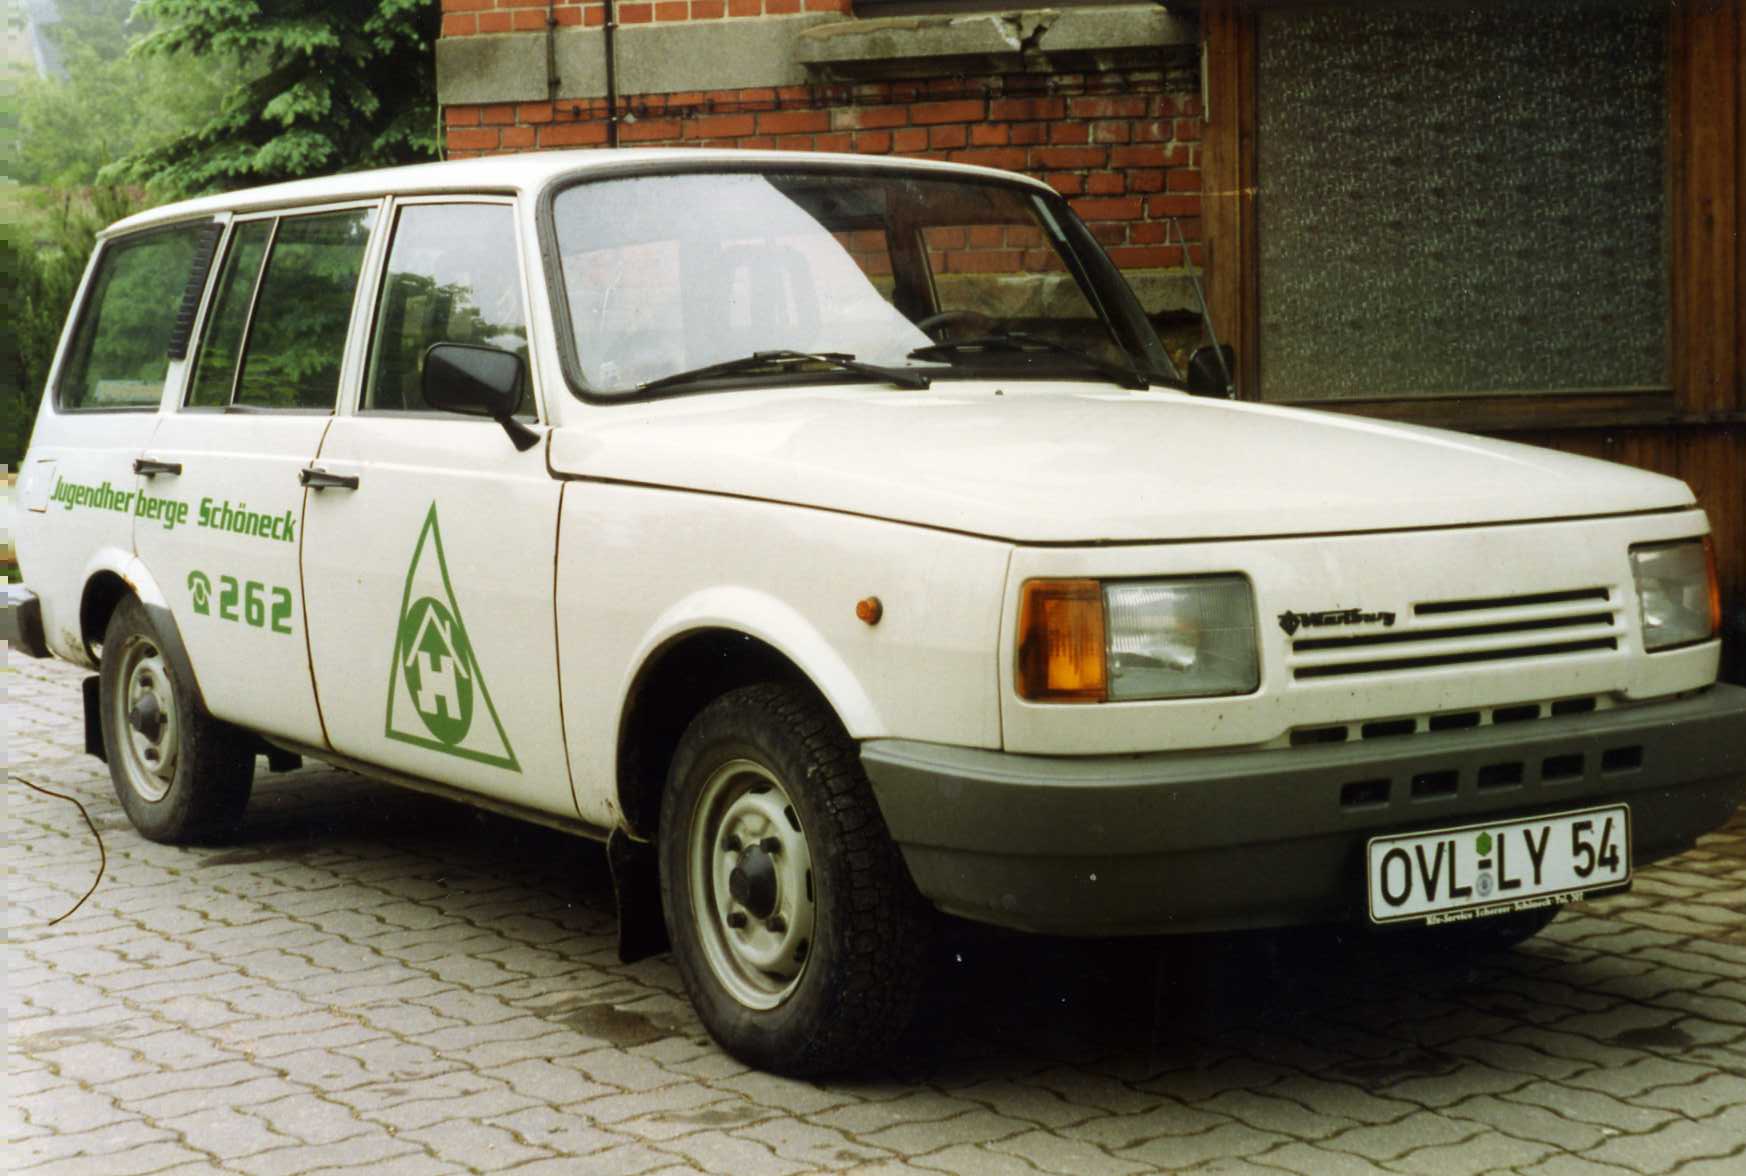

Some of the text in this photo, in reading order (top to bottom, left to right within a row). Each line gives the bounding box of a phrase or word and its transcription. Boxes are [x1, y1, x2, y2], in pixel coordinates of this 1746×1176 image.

[198, 497, 297, 542] Schöneck
[219, 575, 292, 634] 262
[1571, 816, 1620, 879] 54
